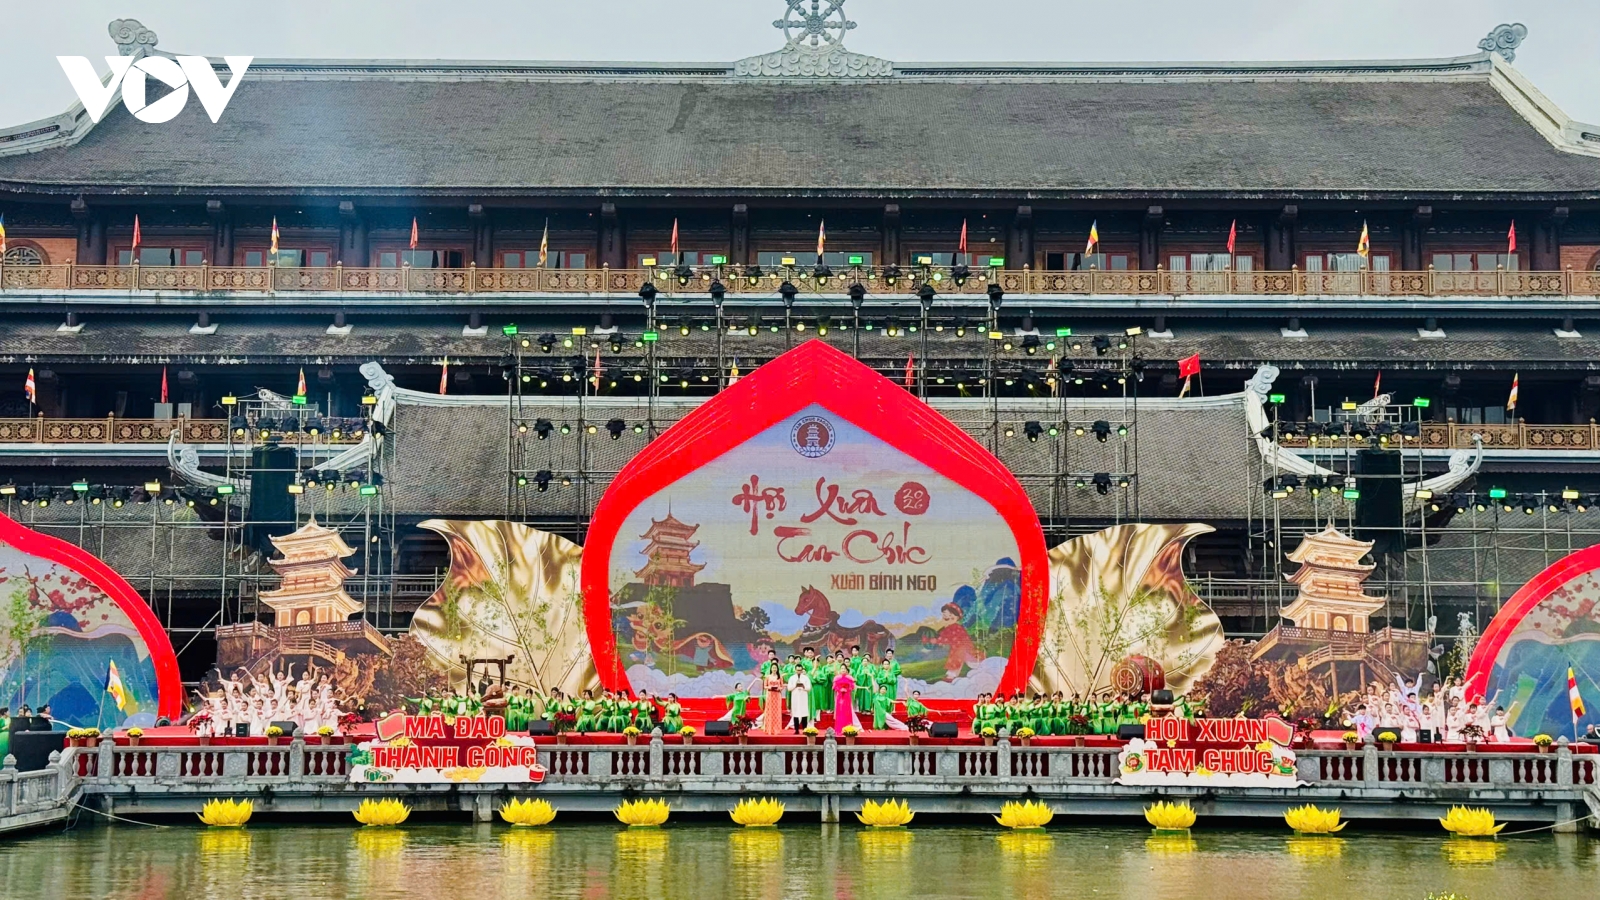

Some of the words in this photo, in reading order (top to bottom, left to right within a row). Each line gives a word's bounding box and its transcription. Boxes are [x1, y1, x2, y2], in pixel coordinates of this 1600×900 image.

[732, 475, 787, 536] Hội
[800, 476, 887, 526] Xuân
[842, 521, 932, 564] Chúc
[906, 575, 937, 592] NGỌ
[404, 711, 446, 738] MÃ
[454, 712, 506, 738] ĐÁO
[1196, 712, 1269, 742] XUÂN
[466, 742, 537, 769] CÔNG
[1144, 748, 1196, 772] TAM
[1203, 744, 1274, 774] CHÚC
